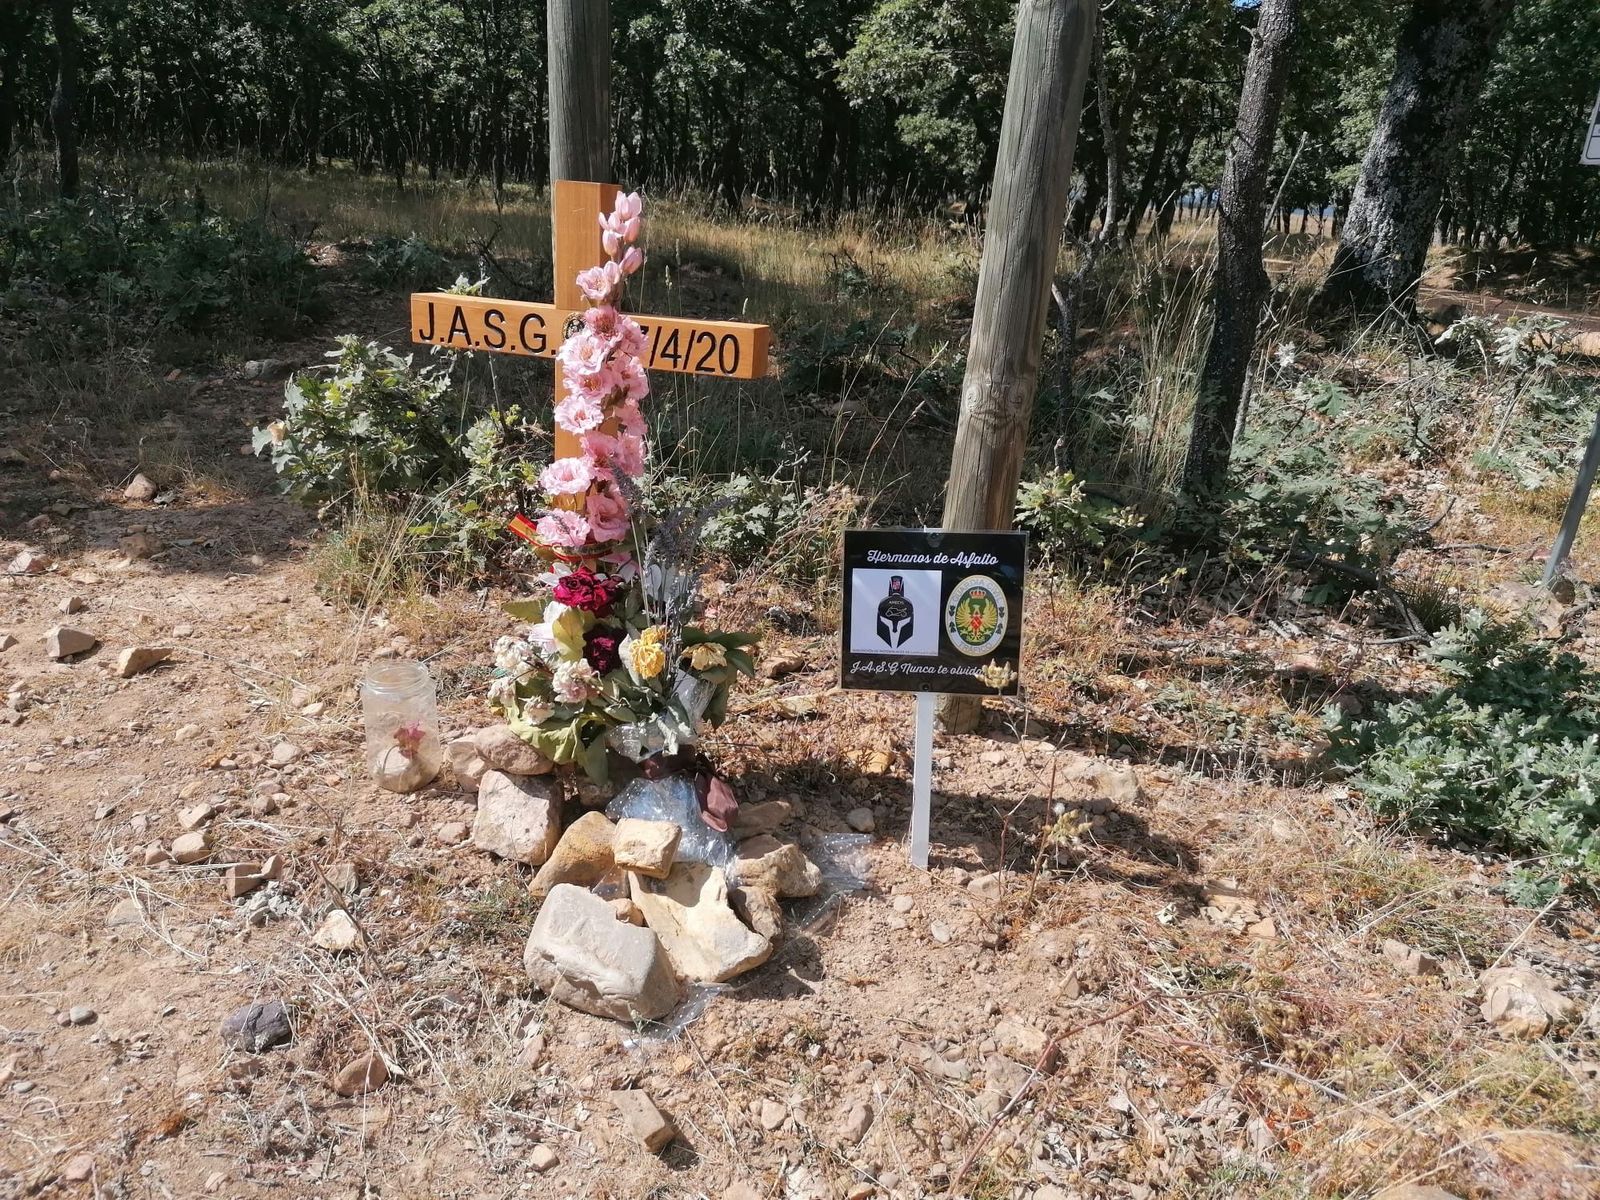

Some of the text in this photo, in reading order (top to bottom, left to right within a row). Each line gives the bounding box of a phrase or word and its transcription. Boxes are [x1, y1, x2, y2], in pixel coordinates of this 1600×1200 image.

[418, 302, 557, 356] J.A.S.G.
[866, 549, 999, 568] Hermanos de Asfalto
[900, 662, 936, 674] Nunca
[937, 664, 948, 674] te
